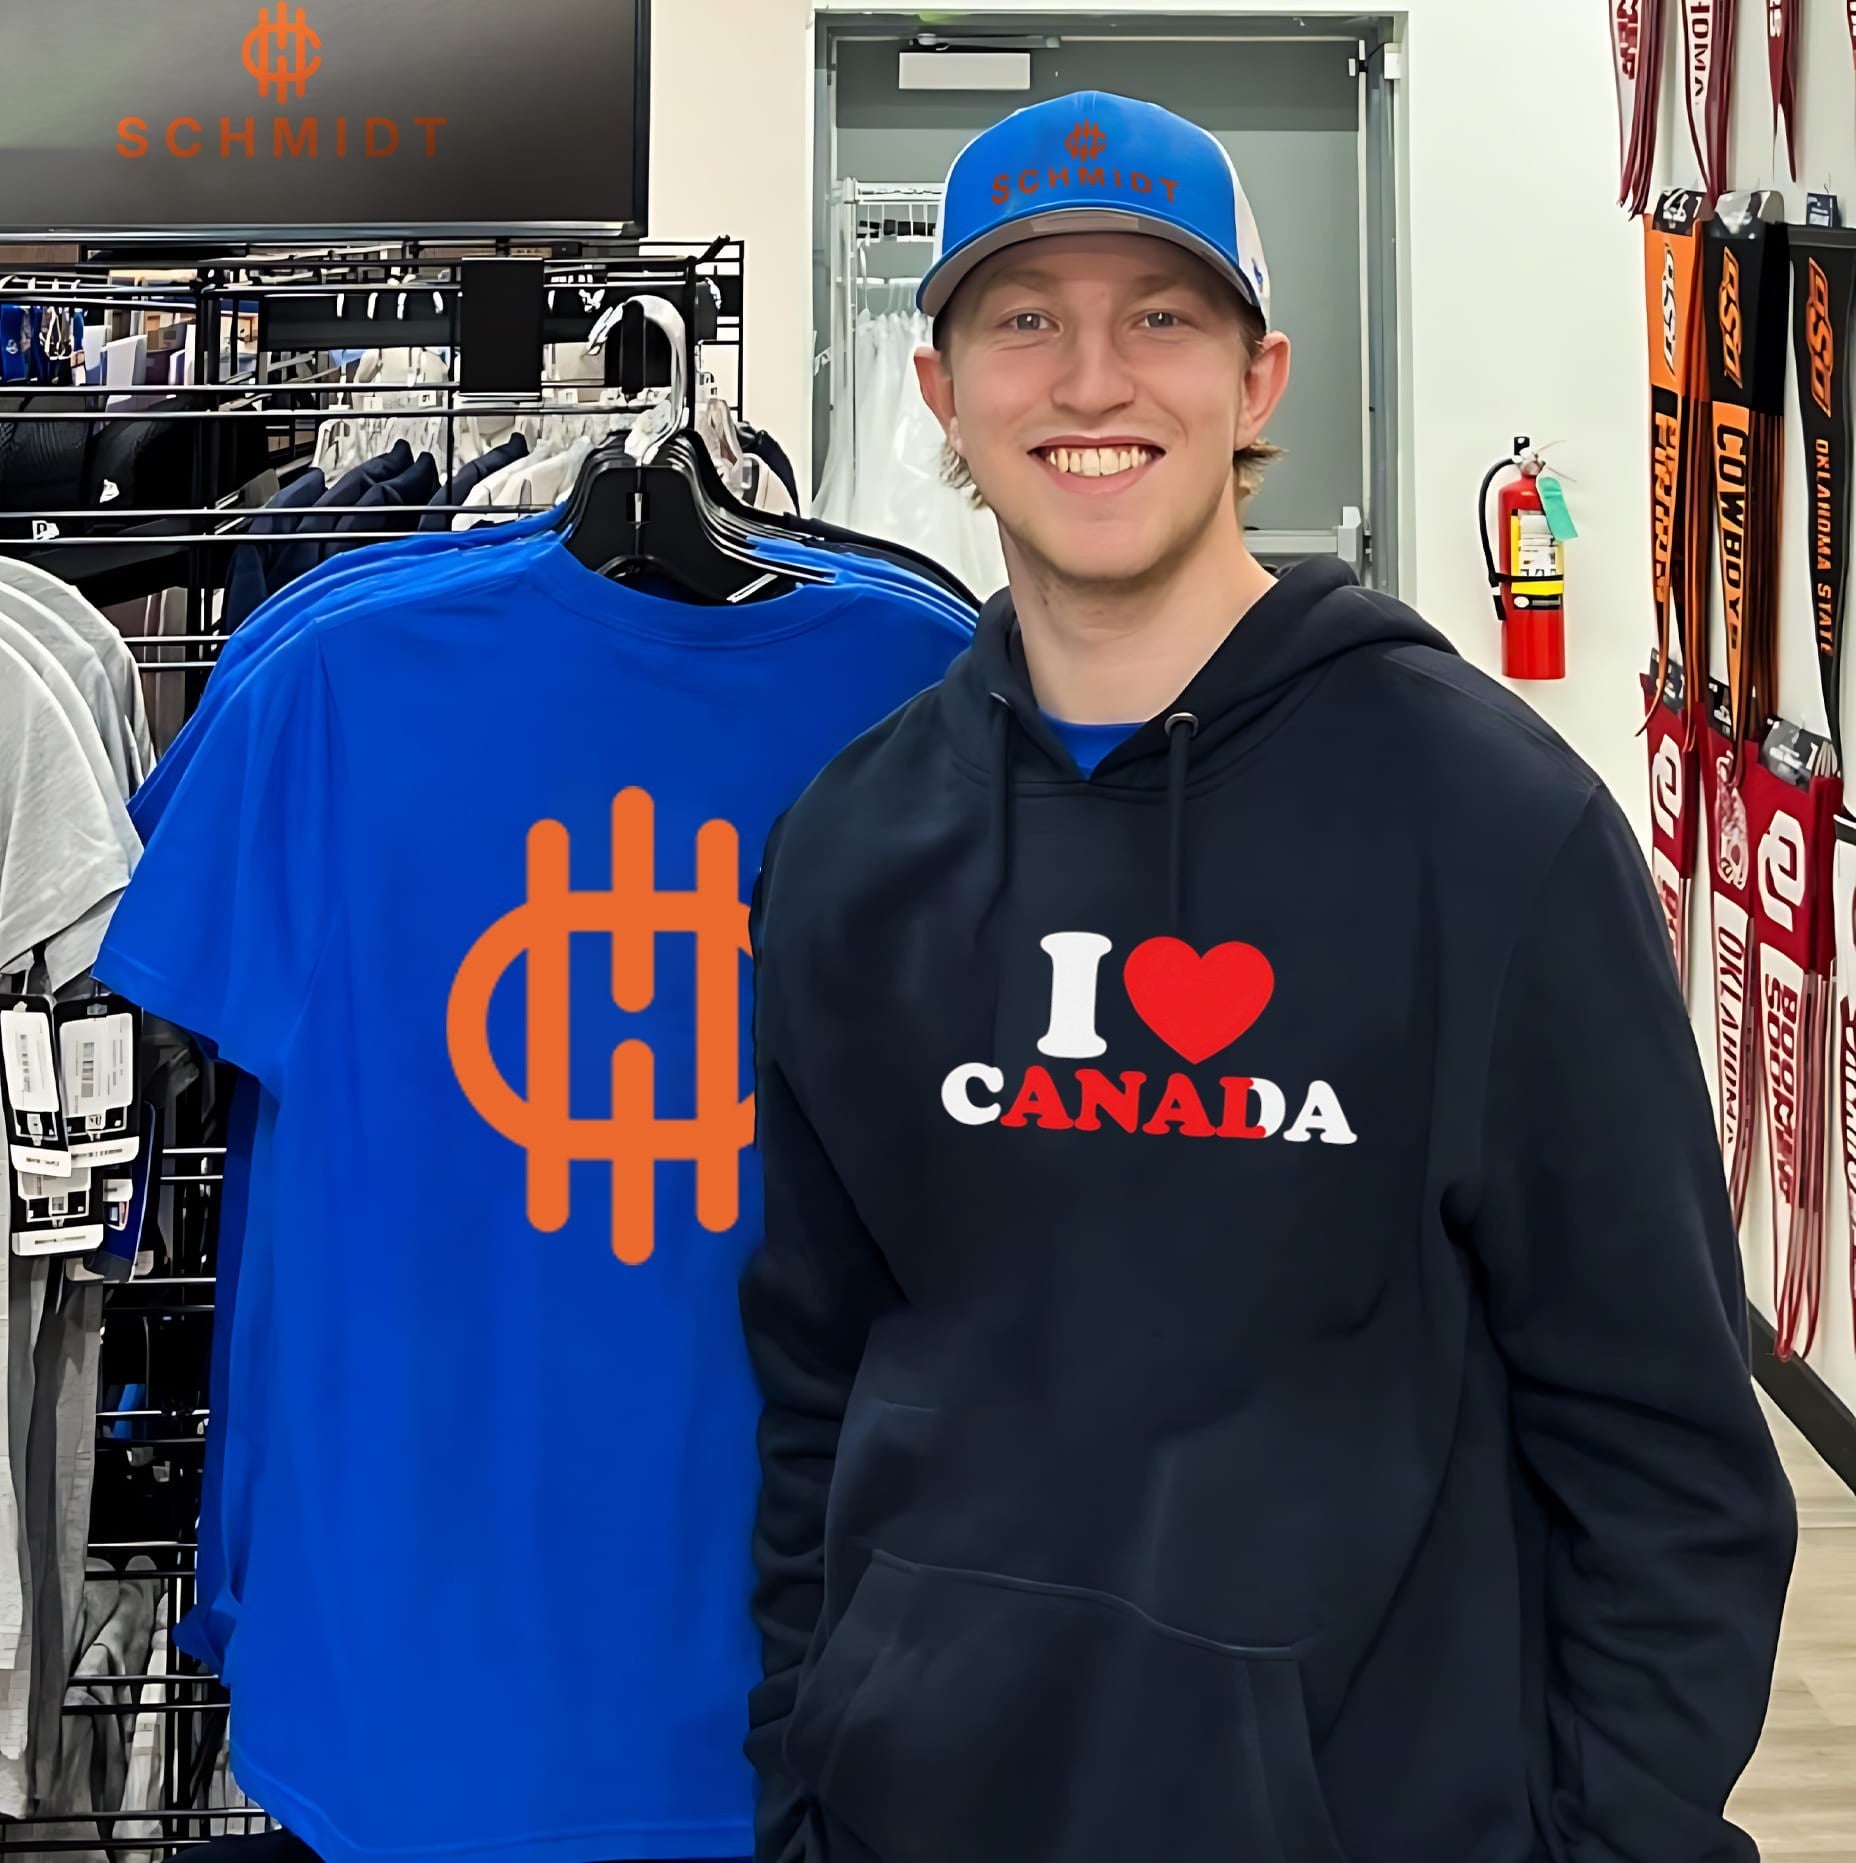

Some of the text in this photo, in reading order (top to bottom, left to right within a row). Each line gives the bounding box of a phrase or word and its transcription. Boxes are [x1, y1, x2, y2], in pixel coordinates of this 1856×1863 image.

[115, 116, 448, 159] SCHMIDT
[991, 166, 1179, 205] SCHMIDT
[1815, 438, 1832, 570] OKLAHOMA
[1036, 931, 1113, 1059] I
[1717, 925, 1745, 1144] OKLAHOMA
